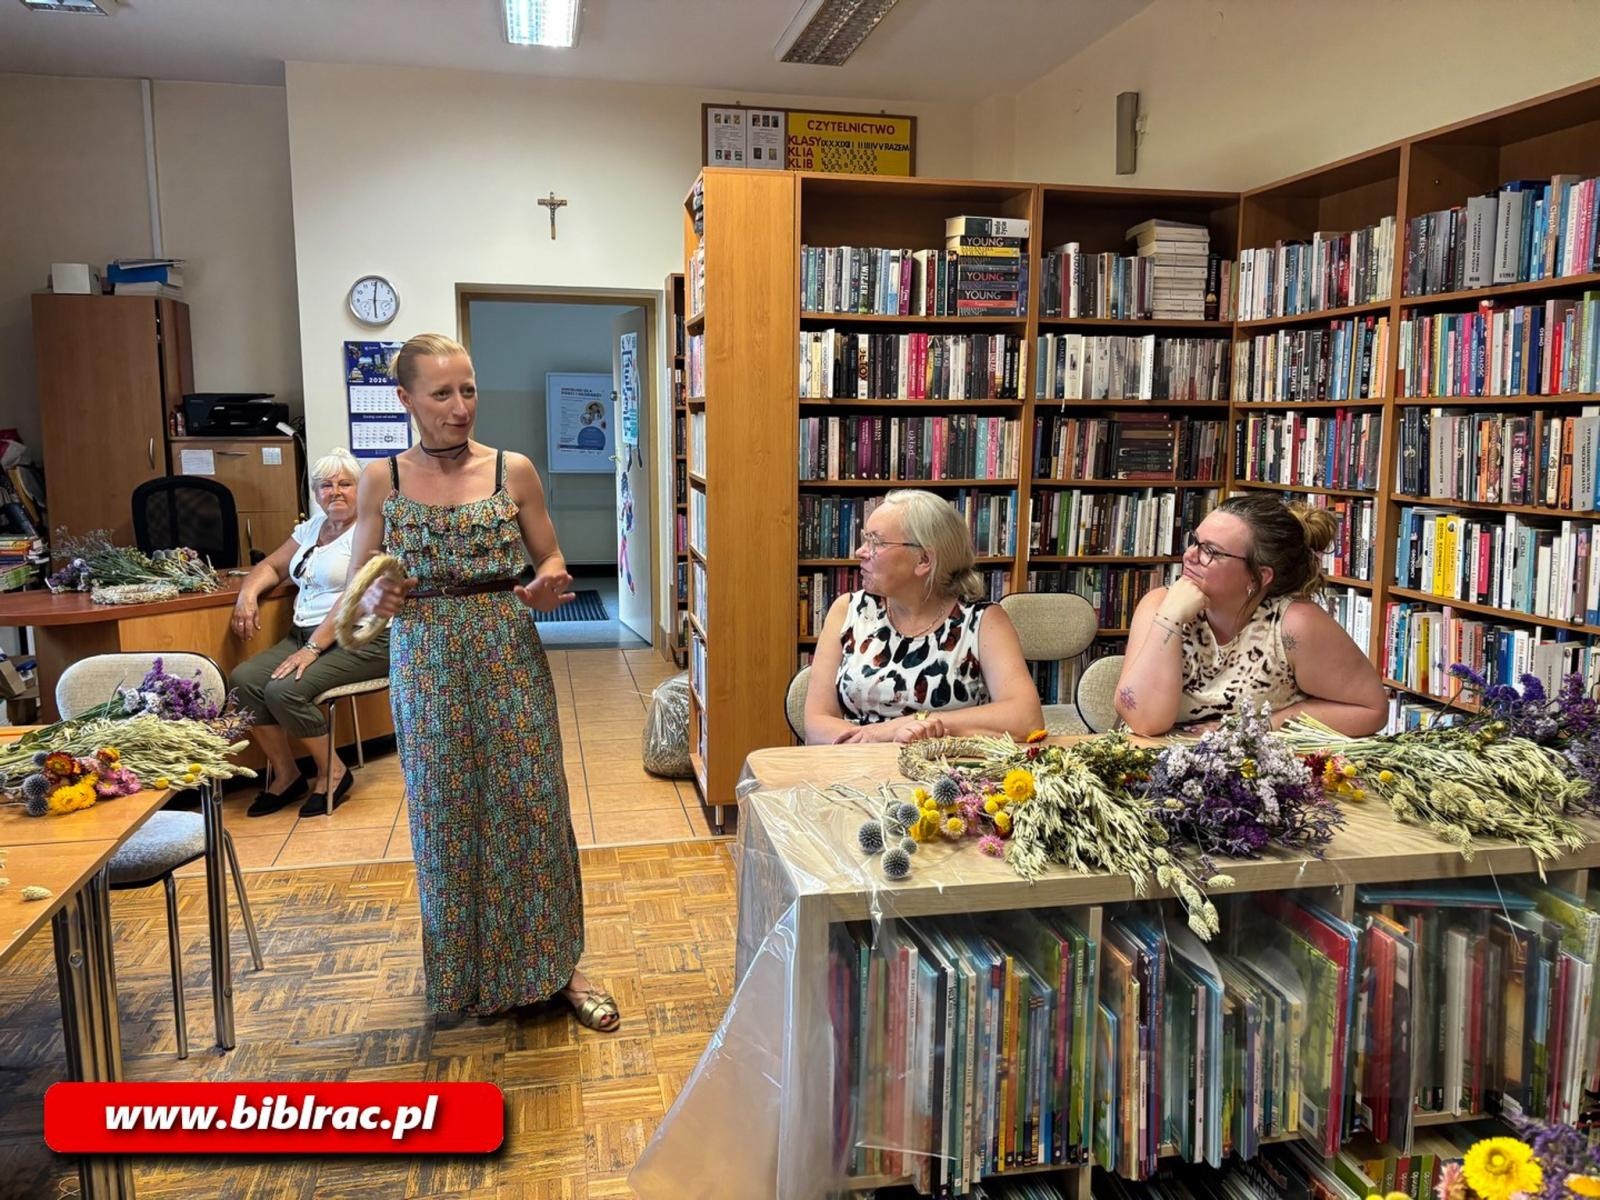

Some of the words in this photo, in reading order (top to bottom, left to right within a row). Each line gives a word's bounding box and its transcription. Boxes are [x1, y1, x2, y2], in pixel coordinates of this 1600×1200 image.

[807, 120, 895, 135] CZYTELNICTWO
[788, 135, 821, 146] KLASY
[967, 237, 1004, 247] YOUNG
[967, 272, 1004, 280] YOUNG
[965, 290, 1001, 300] YOUNG
